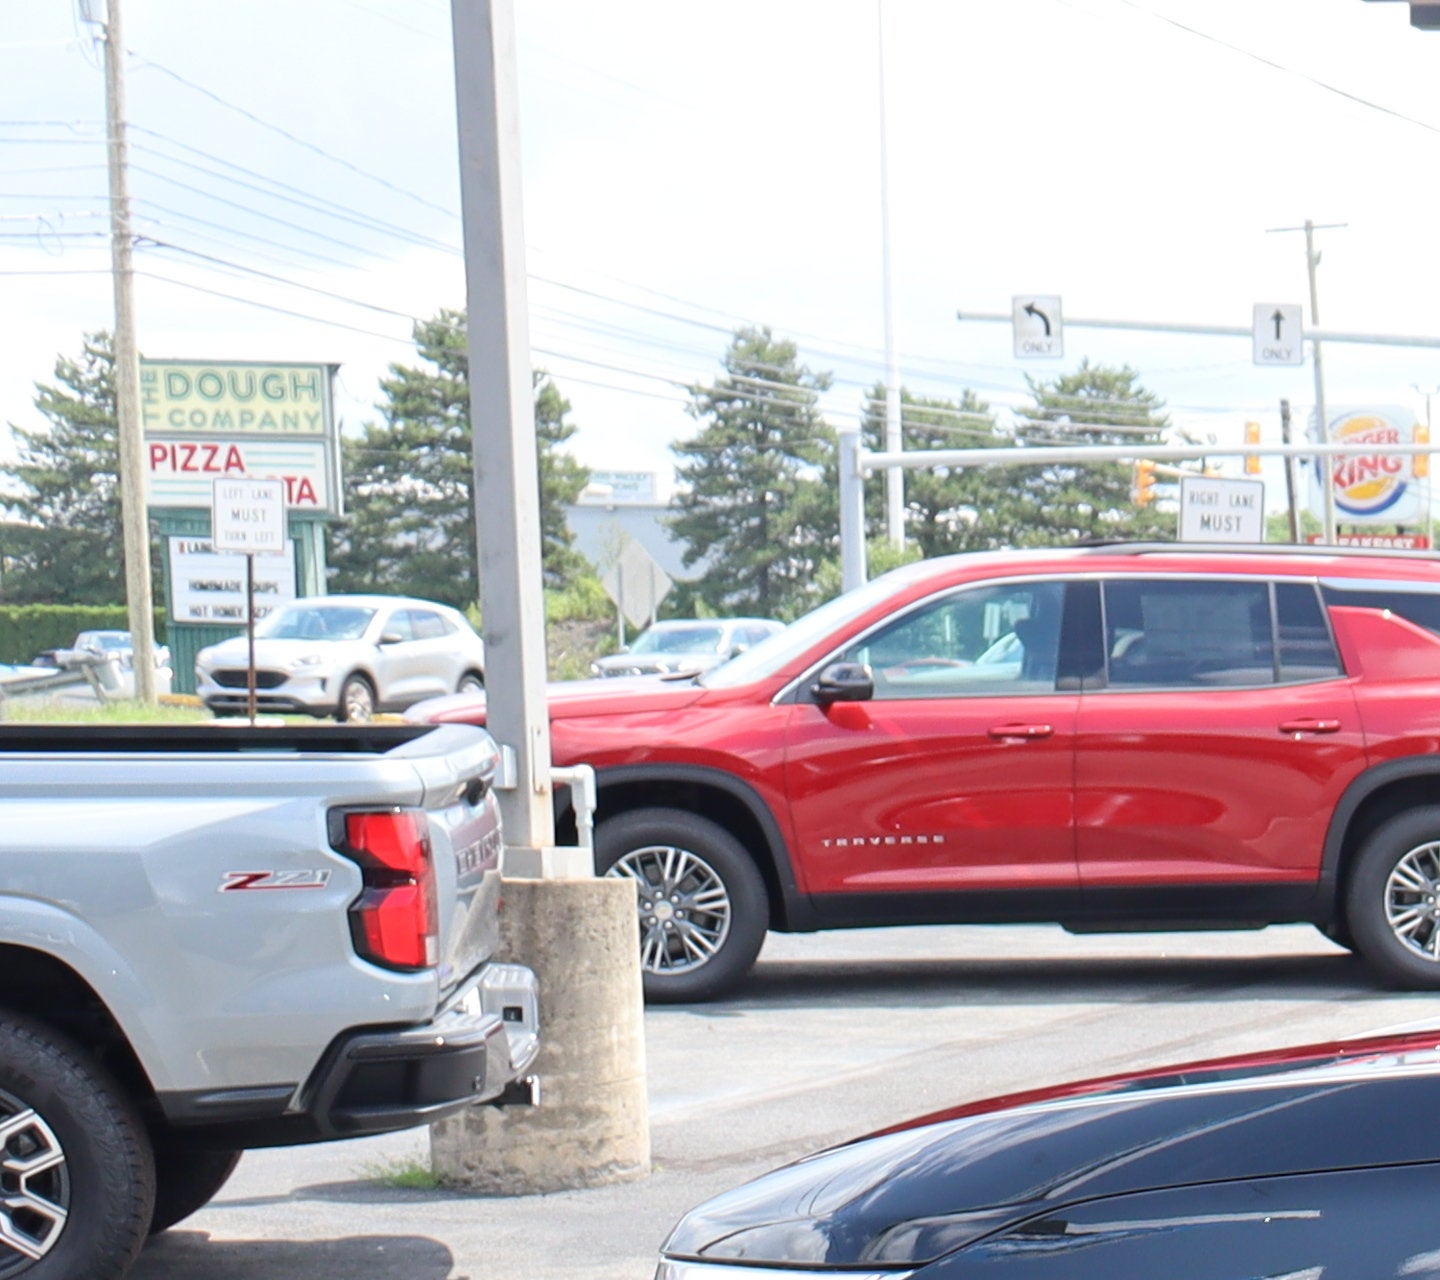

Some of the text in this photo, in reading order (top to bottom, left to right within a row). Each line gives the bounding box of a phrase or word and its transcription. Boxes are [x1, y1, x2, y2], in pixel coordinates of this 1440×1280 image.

[1022, 341, 1053, 353] ONLY
[1262, 347, 1292, 360] ONLY
[164, 369, 321, 402] DOUGH
[168, 408, 321, 430] COMPANY
[150, 443, 245, 473] PIZZA
[222, 487, 243, 500] LEFT
[252, 488, 274, 501] LANE
[1189, 490, 1255, 508] RIGHT LANE
[231, 508, 268, 523] MUST
[1201, 514, 1242, 532] MUST
[224, 530, 275, 543] TURN LEFT
